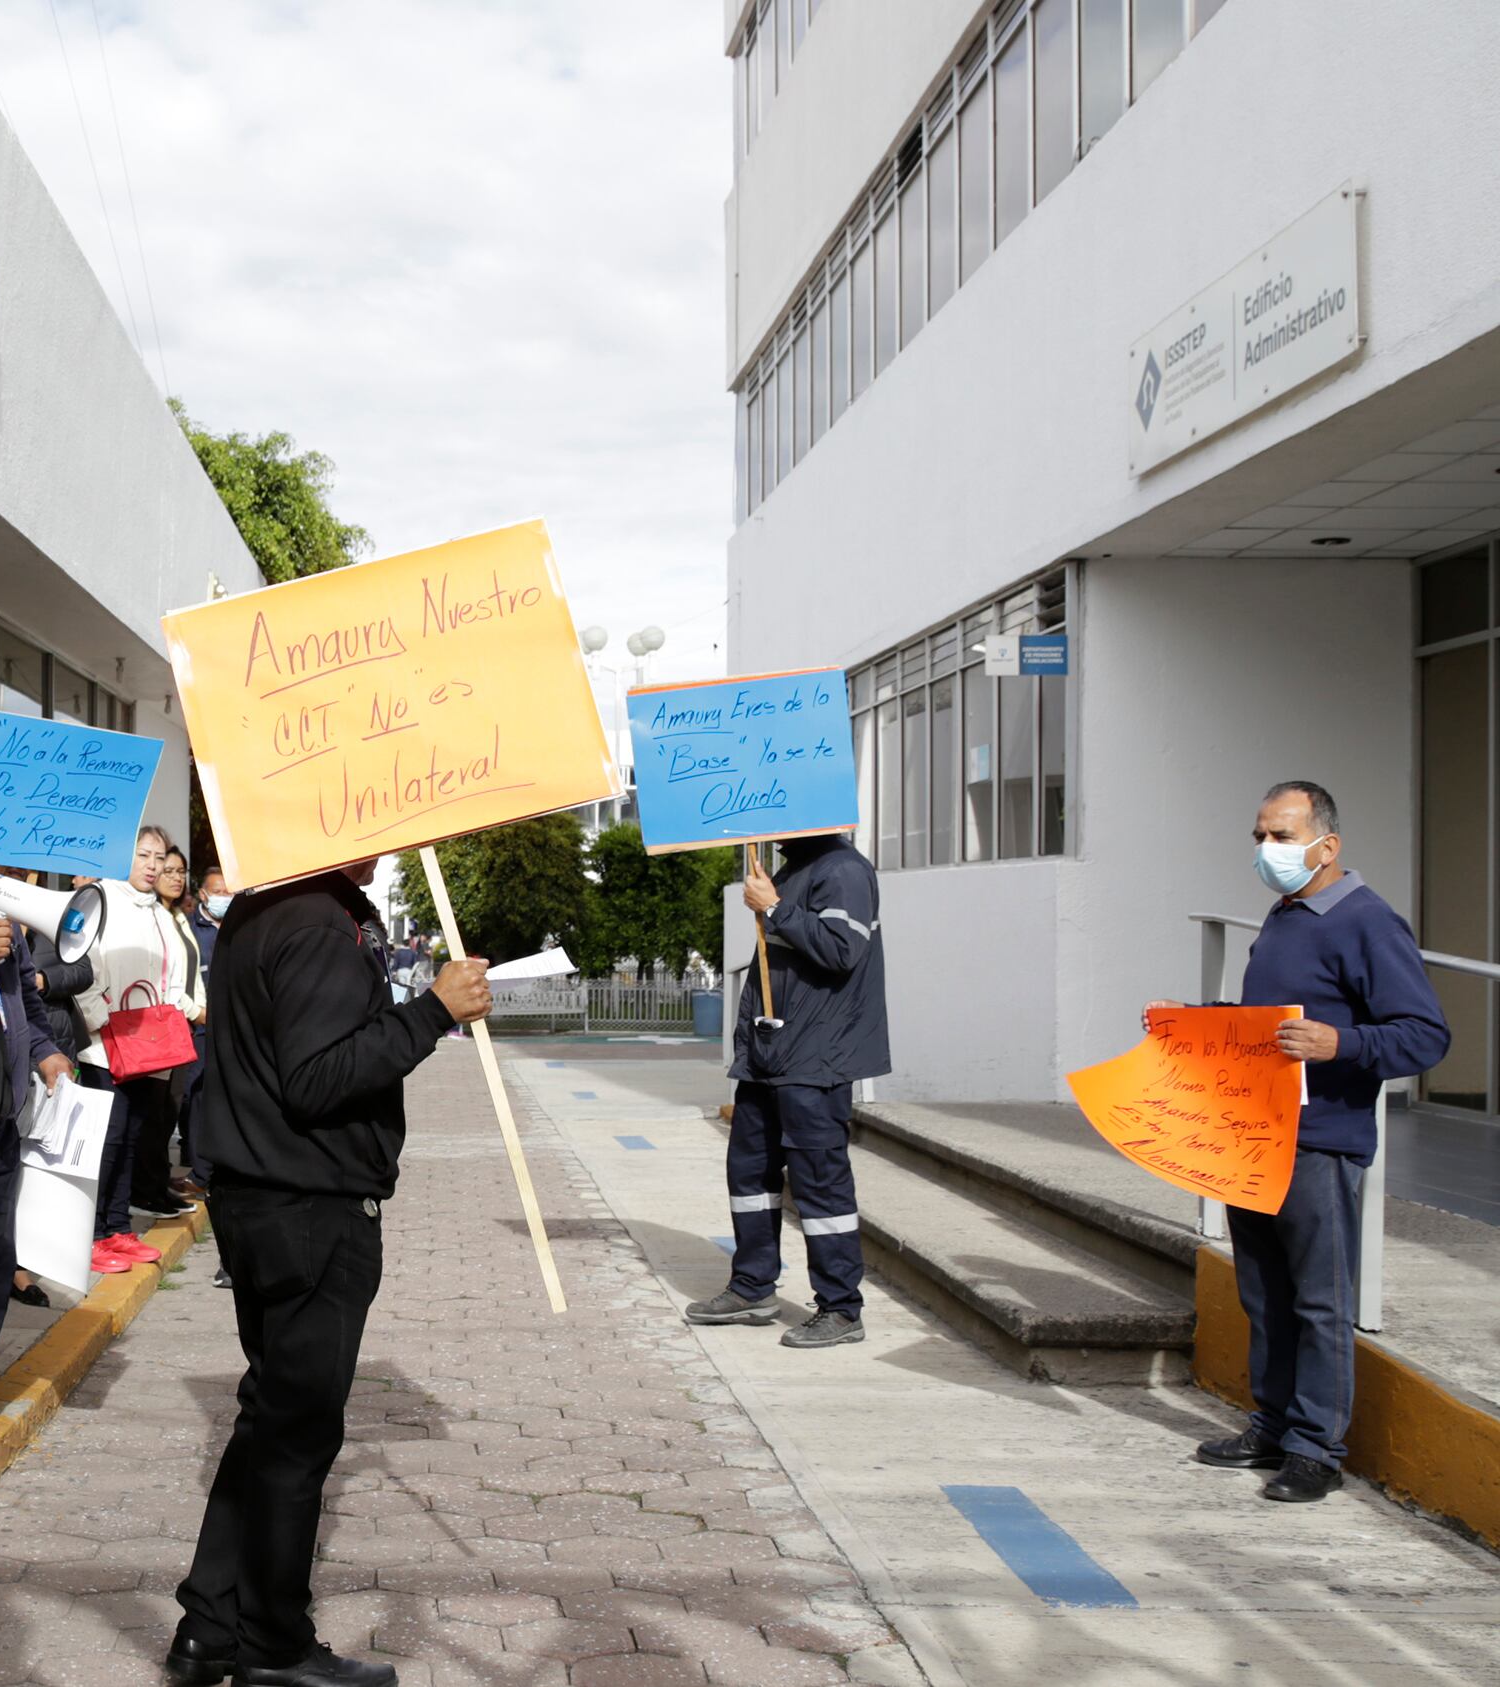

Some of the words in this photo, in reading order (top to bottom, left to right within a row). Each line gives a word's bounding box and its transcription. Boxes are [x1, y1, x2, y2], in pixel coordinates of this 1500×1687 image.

[1243, 271, 1293, 326] Edificio
[1164, 322, 1207, 370] ISSSTEP
[1243, 287, 1346, 371] Administrativo
[245, 611, 407, 689] Amaury
[422, 570, 542, 638] Nuestro
[651, 702, 723, 730] Amaury
[730, 690, 776, 719] Eres
[783, 686, 804, 712] de
[76, 740, 144, 777] Renuncia
[784, 748, 806, 762] se
[813, 737, 835, 760] te
[24, 772, 118, 814] Derechos
[319, 724, 499, 838] Unilateral
[701, 778, 787, 816] Olvido
[1156, 1019, 1192, 1056] Fuera
[1222, 1020, 1278, 1066] Abogados
